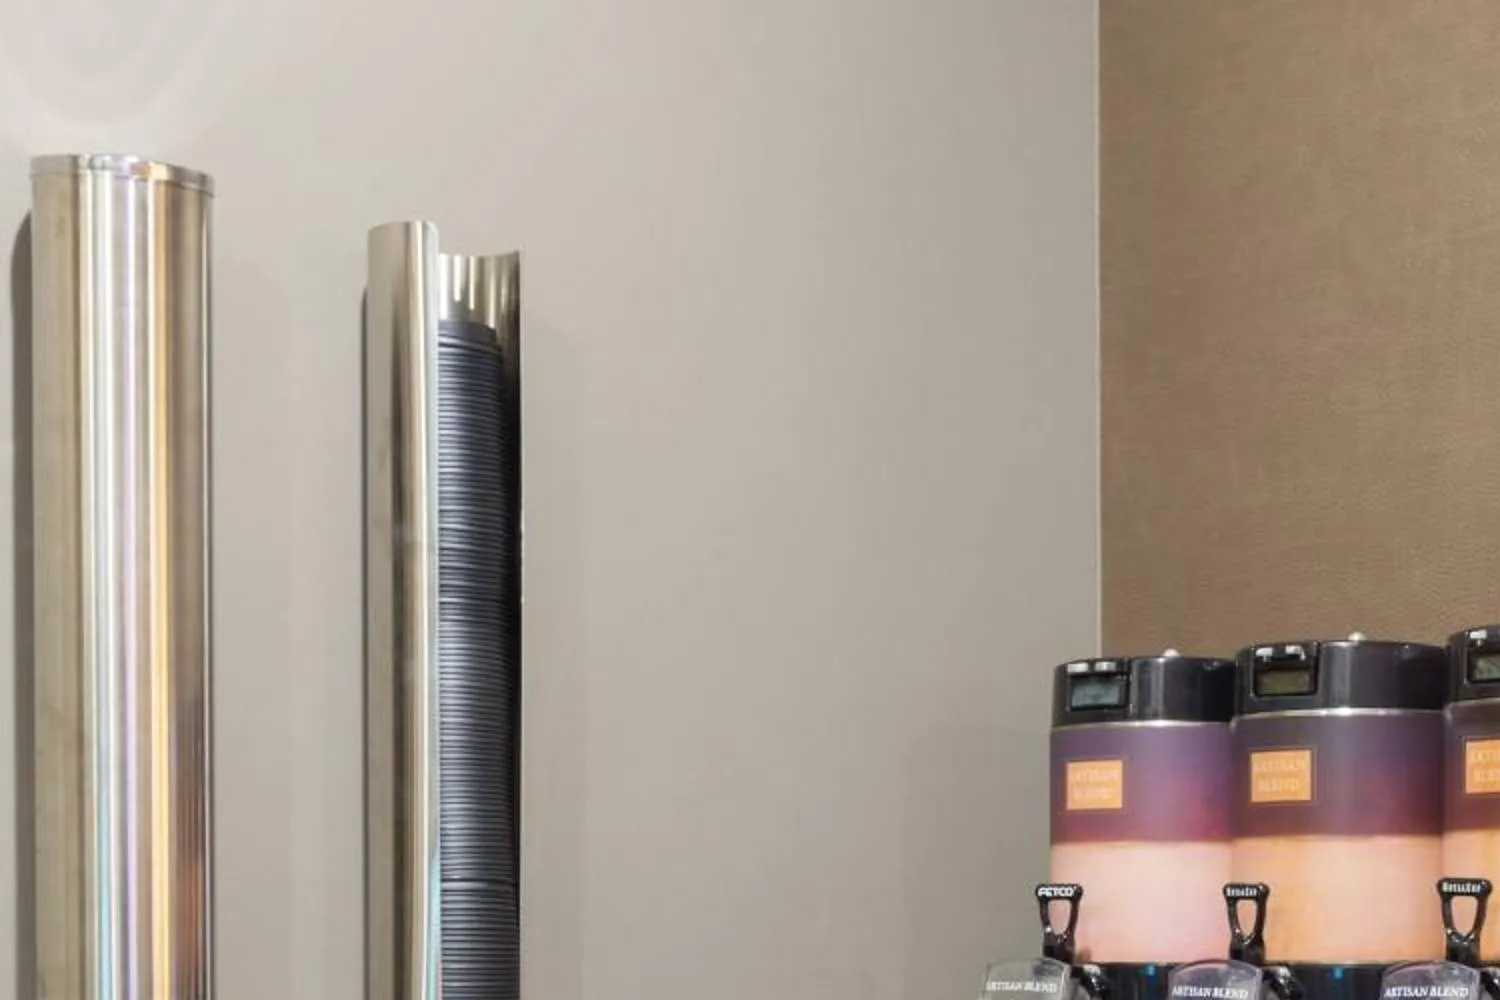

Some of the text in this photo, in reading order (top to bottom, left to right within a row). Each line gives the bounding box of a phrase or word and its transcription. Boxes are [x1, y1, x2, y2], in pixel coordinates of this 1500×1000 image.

[985, 981, 1058, 993] ARTISAN BLEND
[1171, 984, 1249, 1000] ARTISAN BLEND
[1383, 985, 1469, 998] ARTISAN BLEND
